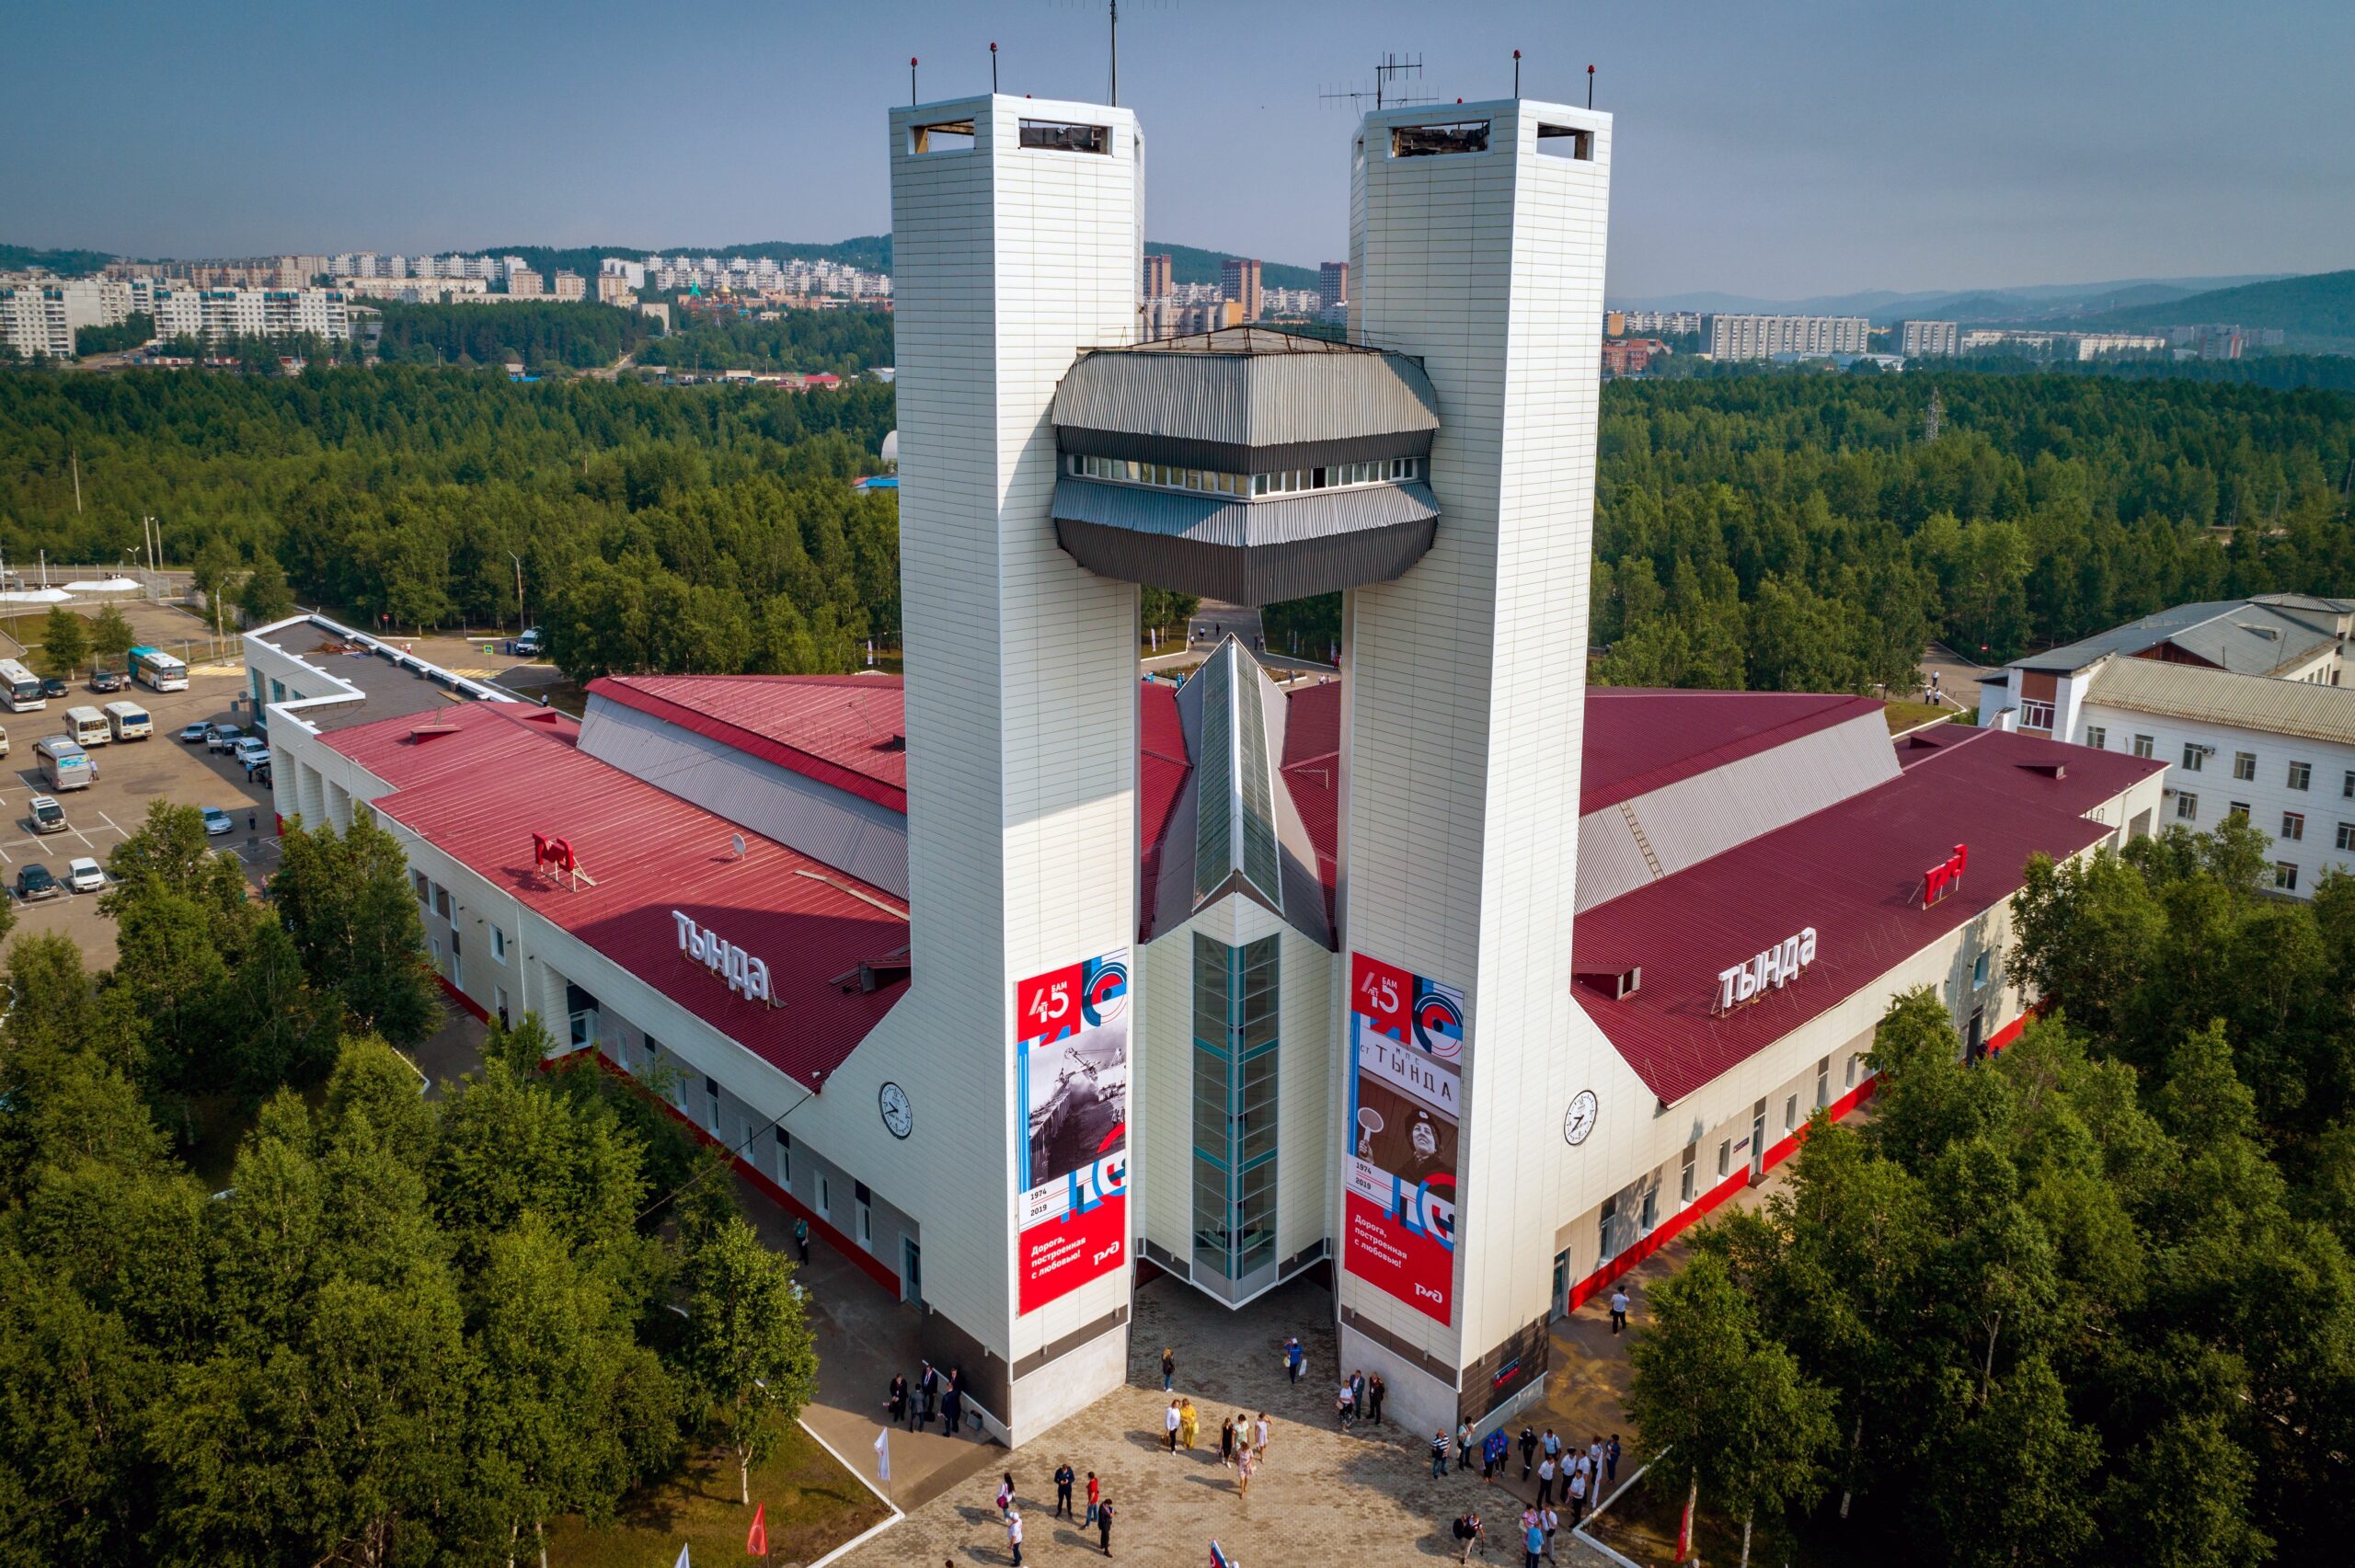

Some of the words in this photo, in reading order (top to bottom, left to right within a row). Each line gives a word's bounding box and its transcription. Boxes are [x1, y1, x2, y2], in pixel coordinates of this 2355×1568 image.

[1051, 980, 1067, 992] БАМ
[1361, 971, 1399, 1013] 45
[1382, 977, 1397, 990] БАМ
[1028, 988, 1070, 1024] 45
[1375, 1044, 1452, 1102] ТЫНДА
[1356, 1162, 1372, 1175] 1974
[1030, 1188, 1047, 1201] 1974
[1355, 1177, 1372, 1190] 2019
[1030, 1204, 1048, 1217] 2019
[1354, 1214, 1387, 1239] Дорога,
[1031, 1236, 1065, 1257] Дорога,
[1031, 1237, 1086, 1268] построенная
[1354, 1227, 1407, 1260] построенная
[1361, 1241, 1402, 1268] любовью!
[1039, 1249, 1081, 1276] любовью!
